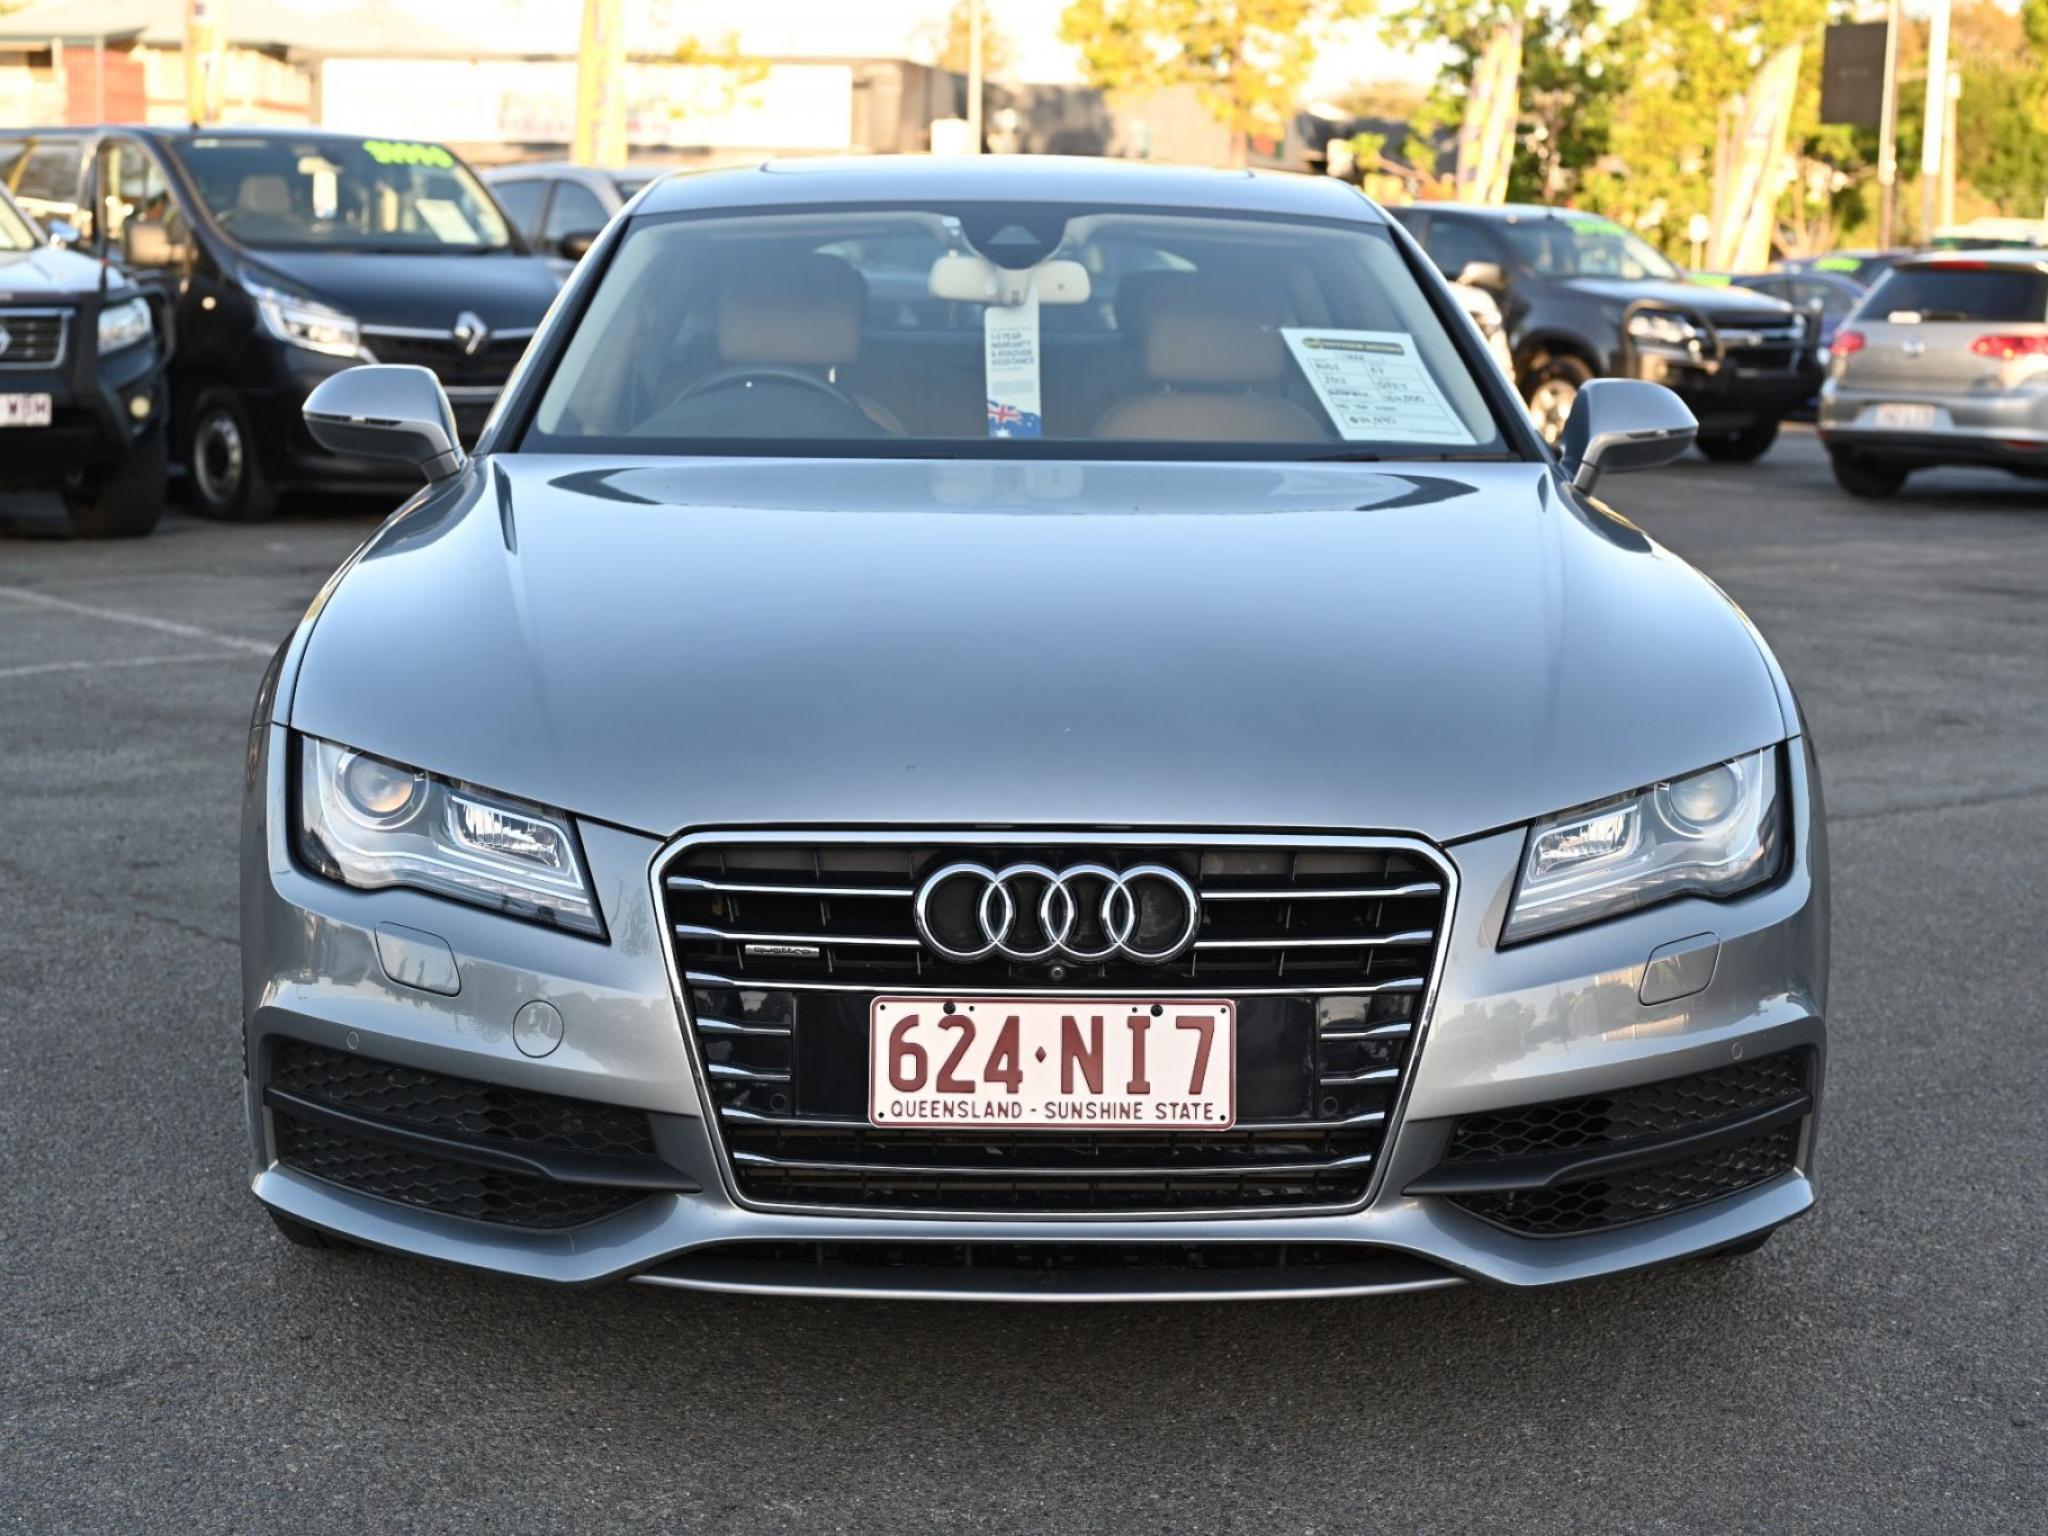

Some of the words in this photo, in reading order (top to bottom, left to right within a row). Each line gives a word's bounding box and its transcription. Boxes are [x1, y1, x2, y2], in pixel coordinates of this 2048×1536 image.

[890, 1100, 1023, 1119] QUEENSLAND
[1044, 1101, 1143, 1120] SUNSHINE
[1155, 1102, 1214, 1121] STATE
